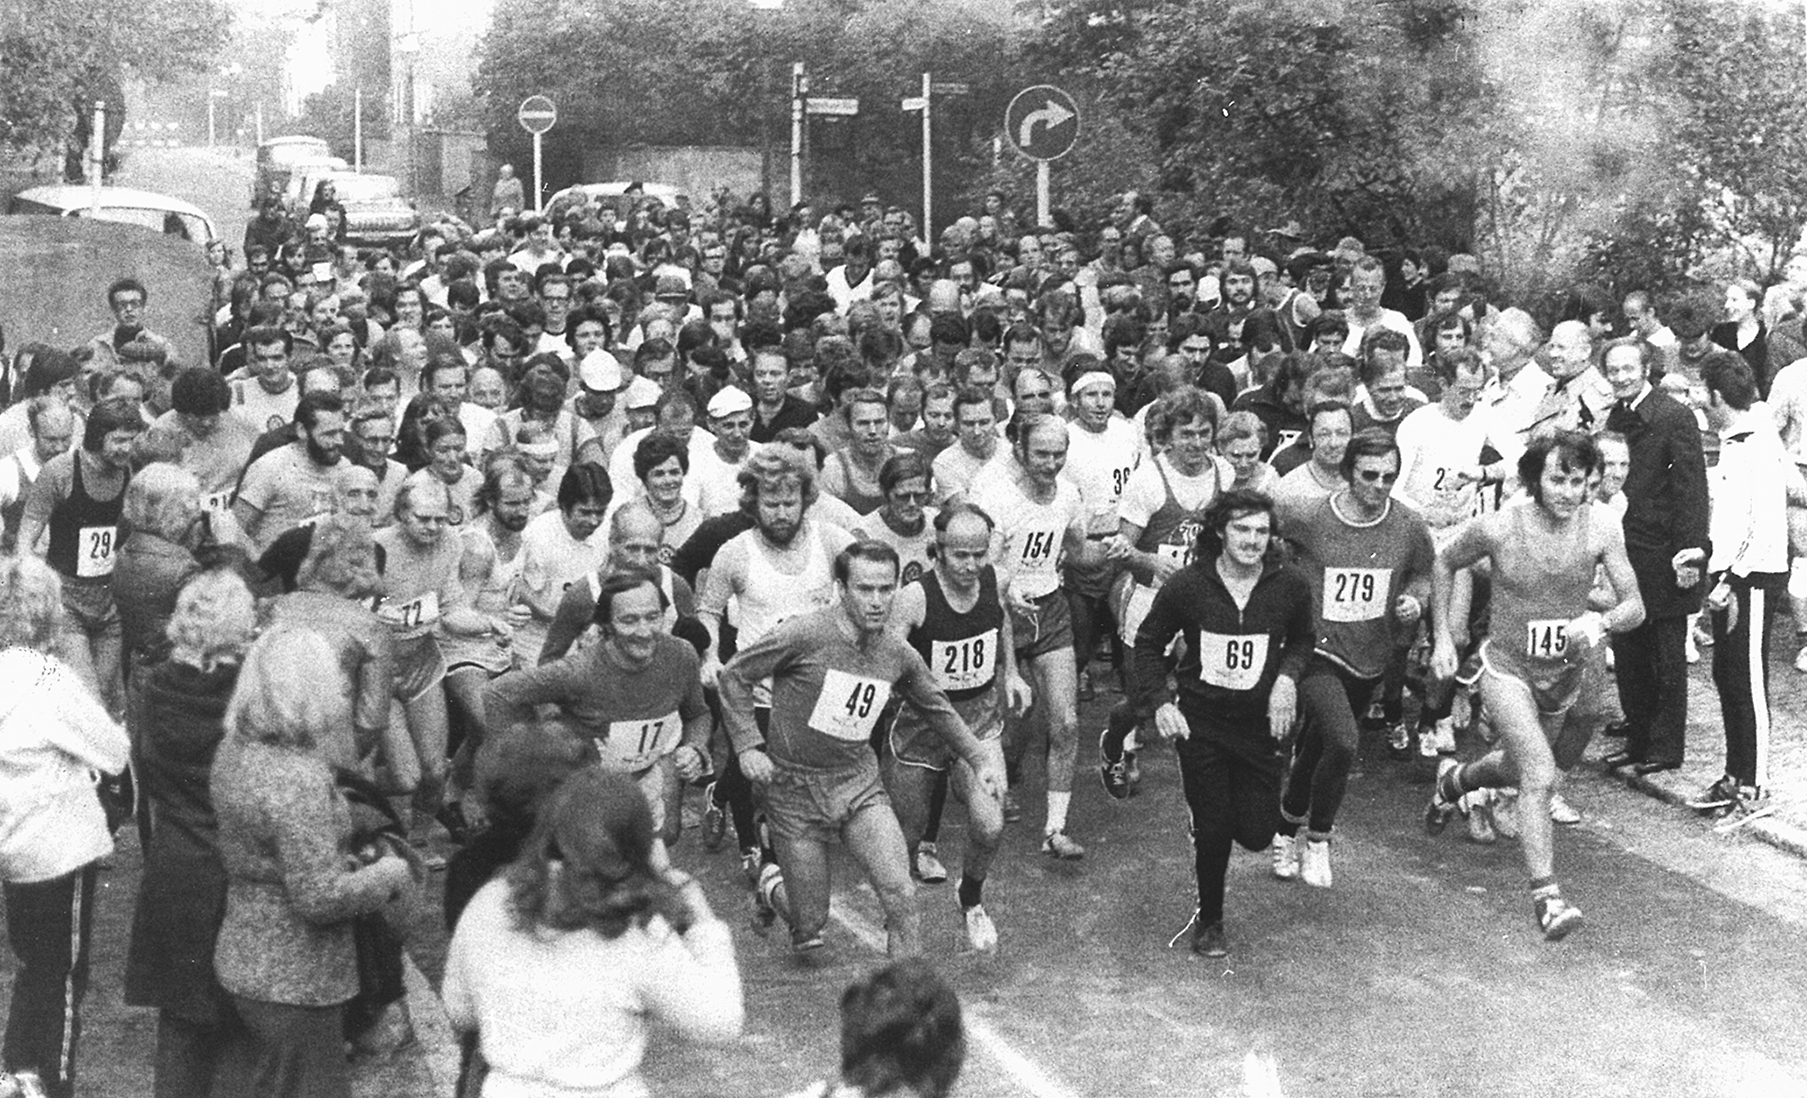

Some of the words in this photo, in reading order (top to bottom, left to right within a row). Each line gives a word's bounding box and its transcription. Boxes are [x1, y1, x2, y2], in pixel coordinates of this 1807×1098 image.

[90, 532, 110, 558] 29
[1022, 531, 1054, 558] 154
[1335, 573, 1374, 602] 279
[402, 600, 423, 627] 72
[1226, 640, 1253, 670] 69
[1531, 626, 1566, 655] 145
[944, 639, 984, 673] 218
[846, 682, 875, 718] 49
[638, 721, 663, 753] 17
